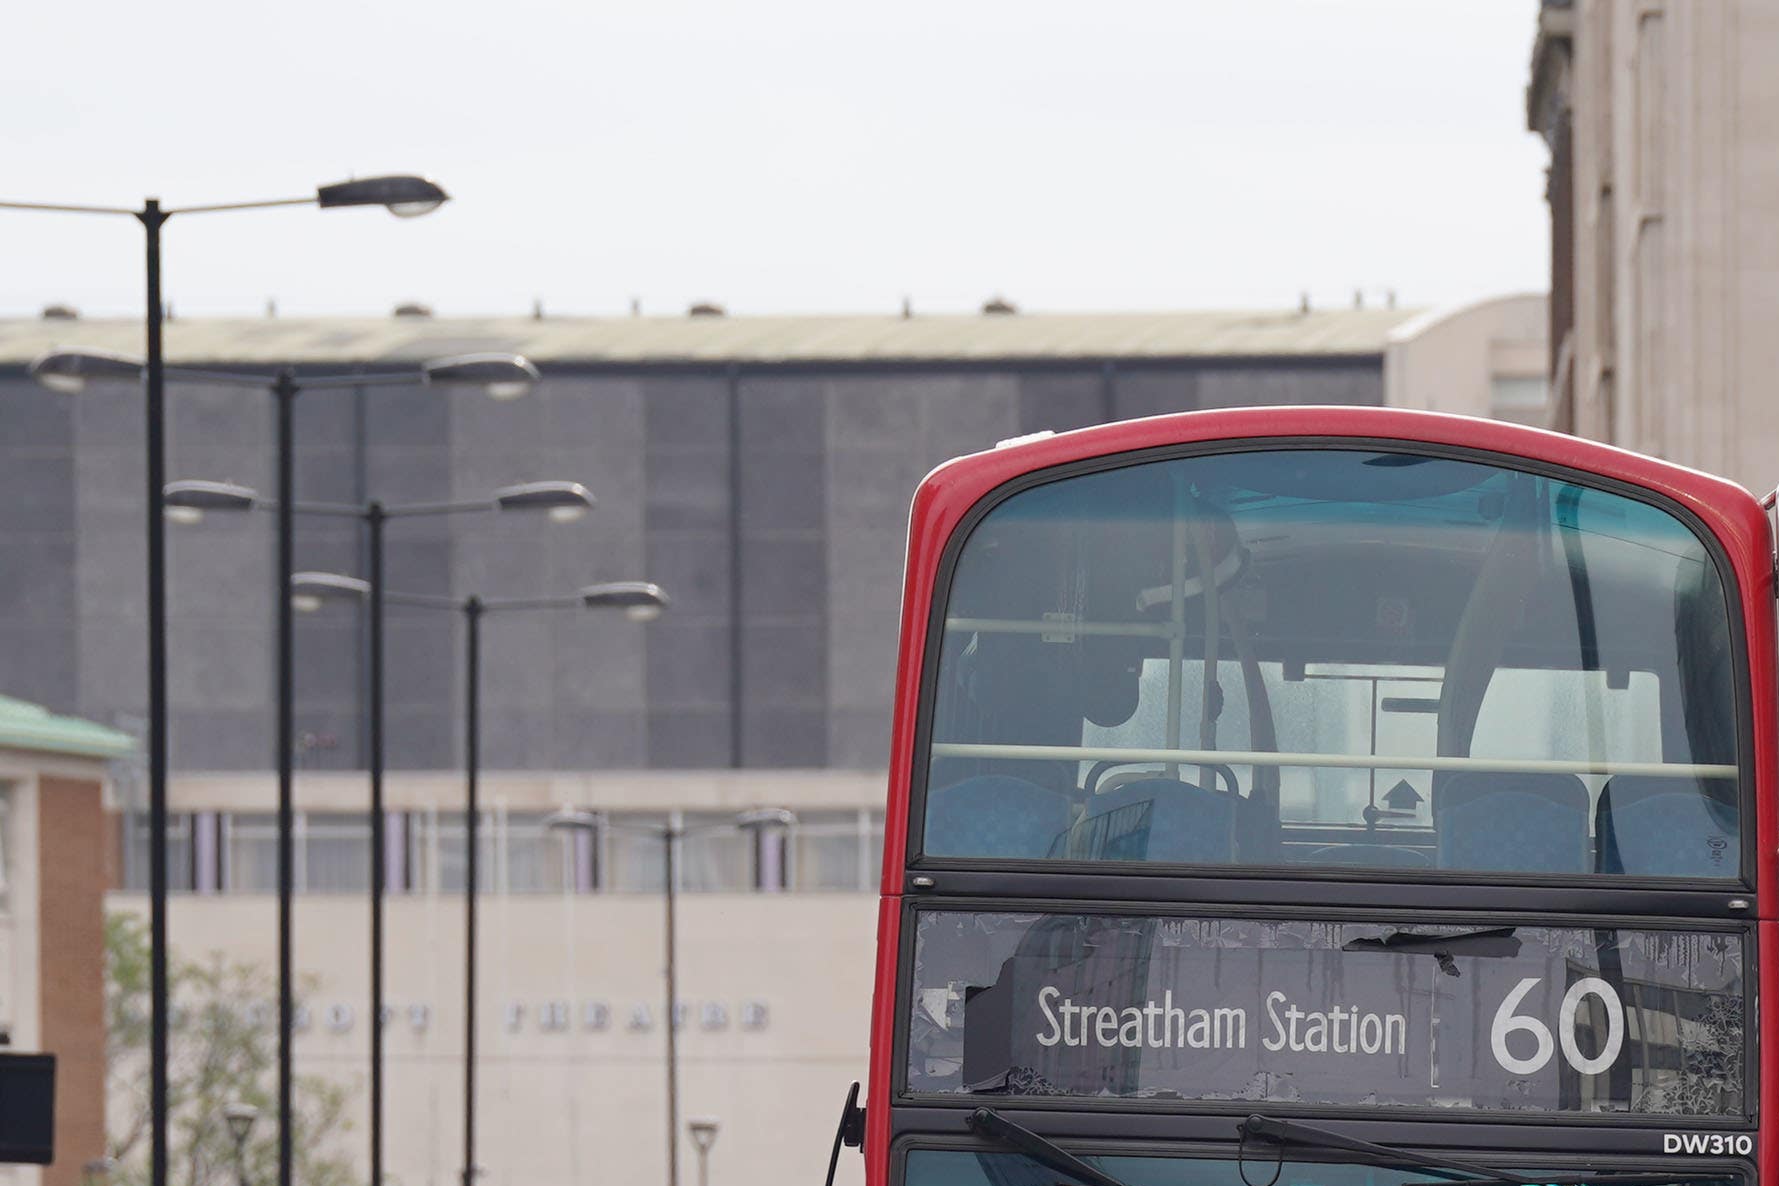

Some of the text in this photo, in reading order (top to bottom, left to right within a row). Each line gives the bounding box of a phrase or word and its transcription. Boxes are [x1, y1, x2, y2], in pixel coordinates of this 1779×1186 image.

[1035, 985, 1407, 1056] Streatham Station
[1490, 977, 1626, 1076] 60
[1663, 1133, 1753, 1156] DW310
